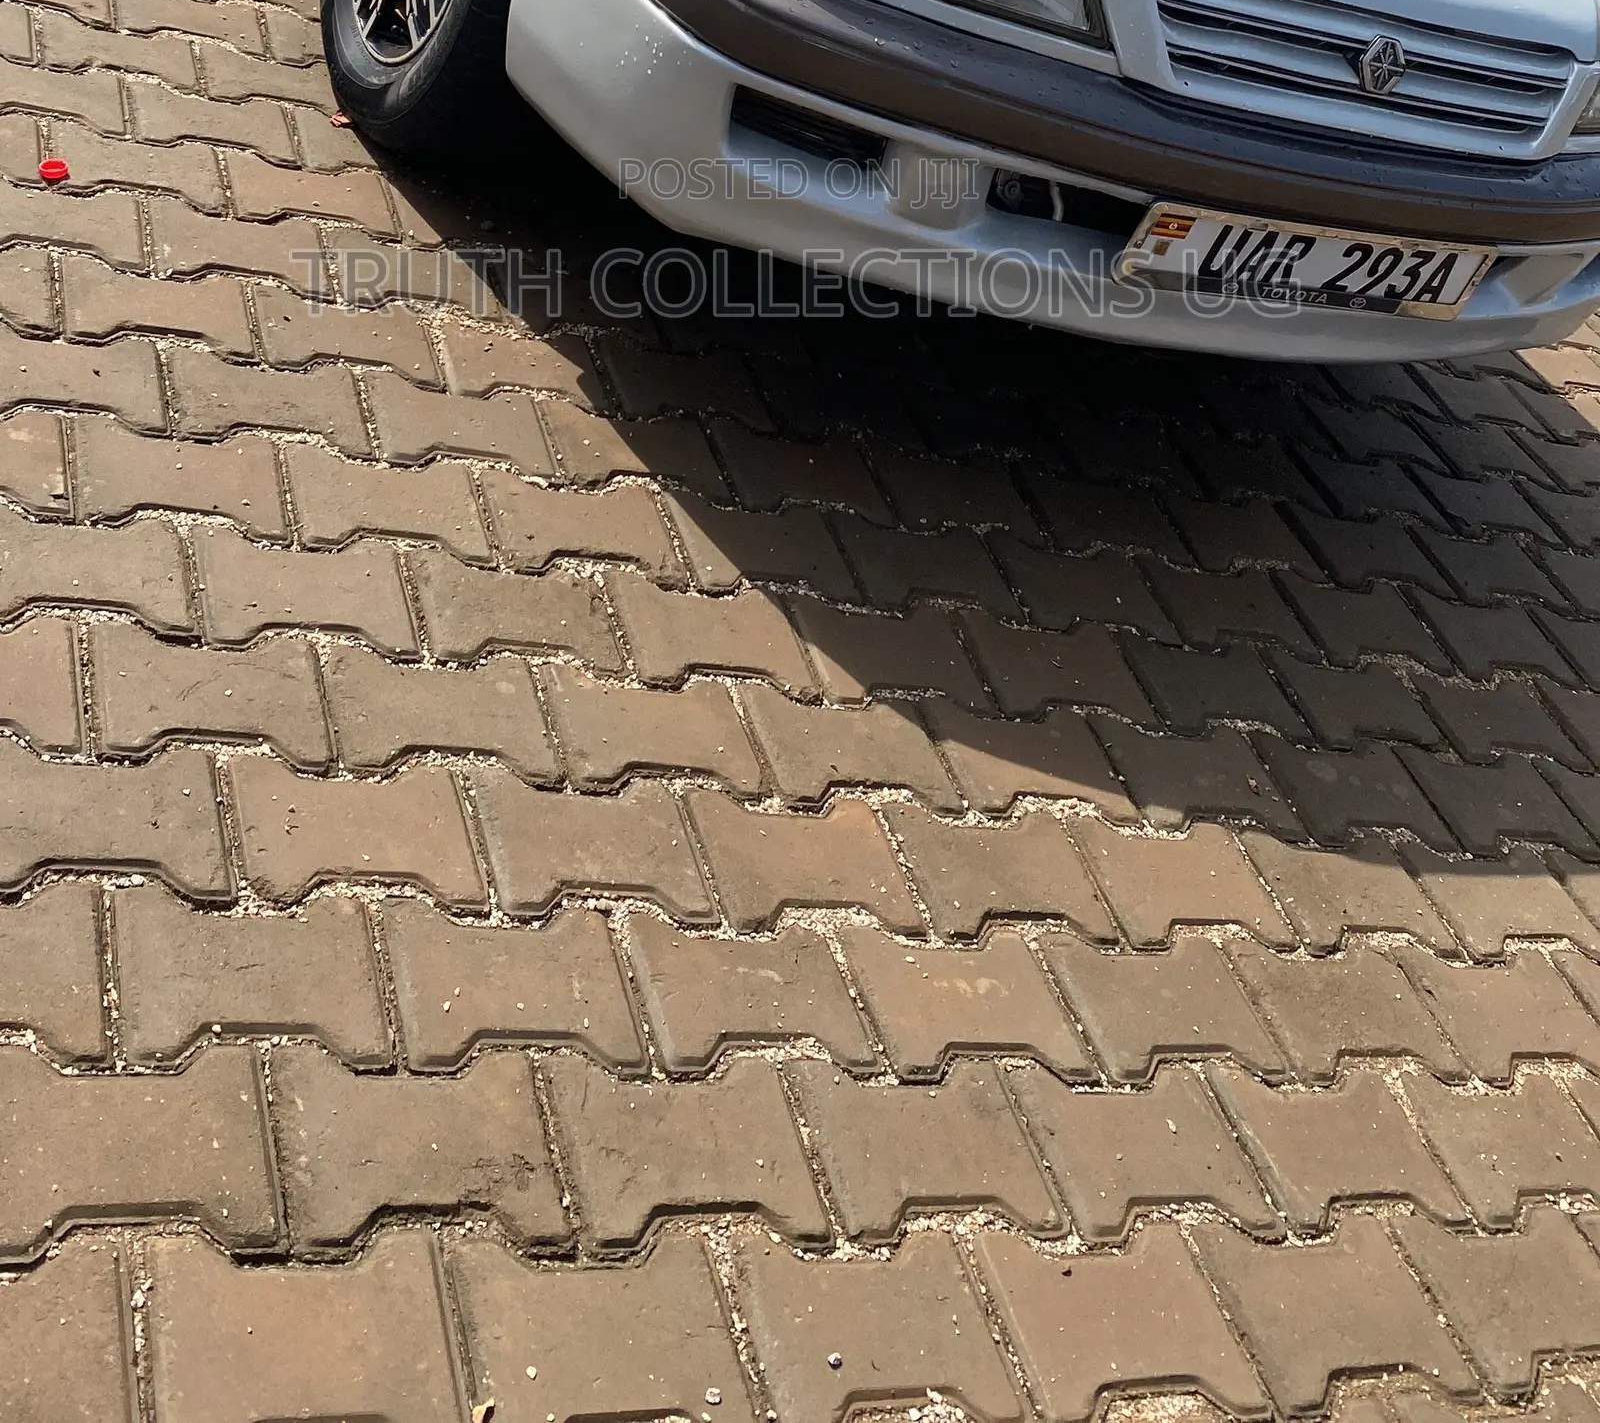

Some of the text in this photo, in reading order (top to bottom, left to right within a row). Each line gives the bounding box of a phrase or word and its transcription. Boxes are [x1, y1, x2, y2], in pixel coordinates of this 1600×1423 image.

[1197, 224, 1459, 305] UAR 293A
[1261, 285, 1328, 305] TOYOTA
